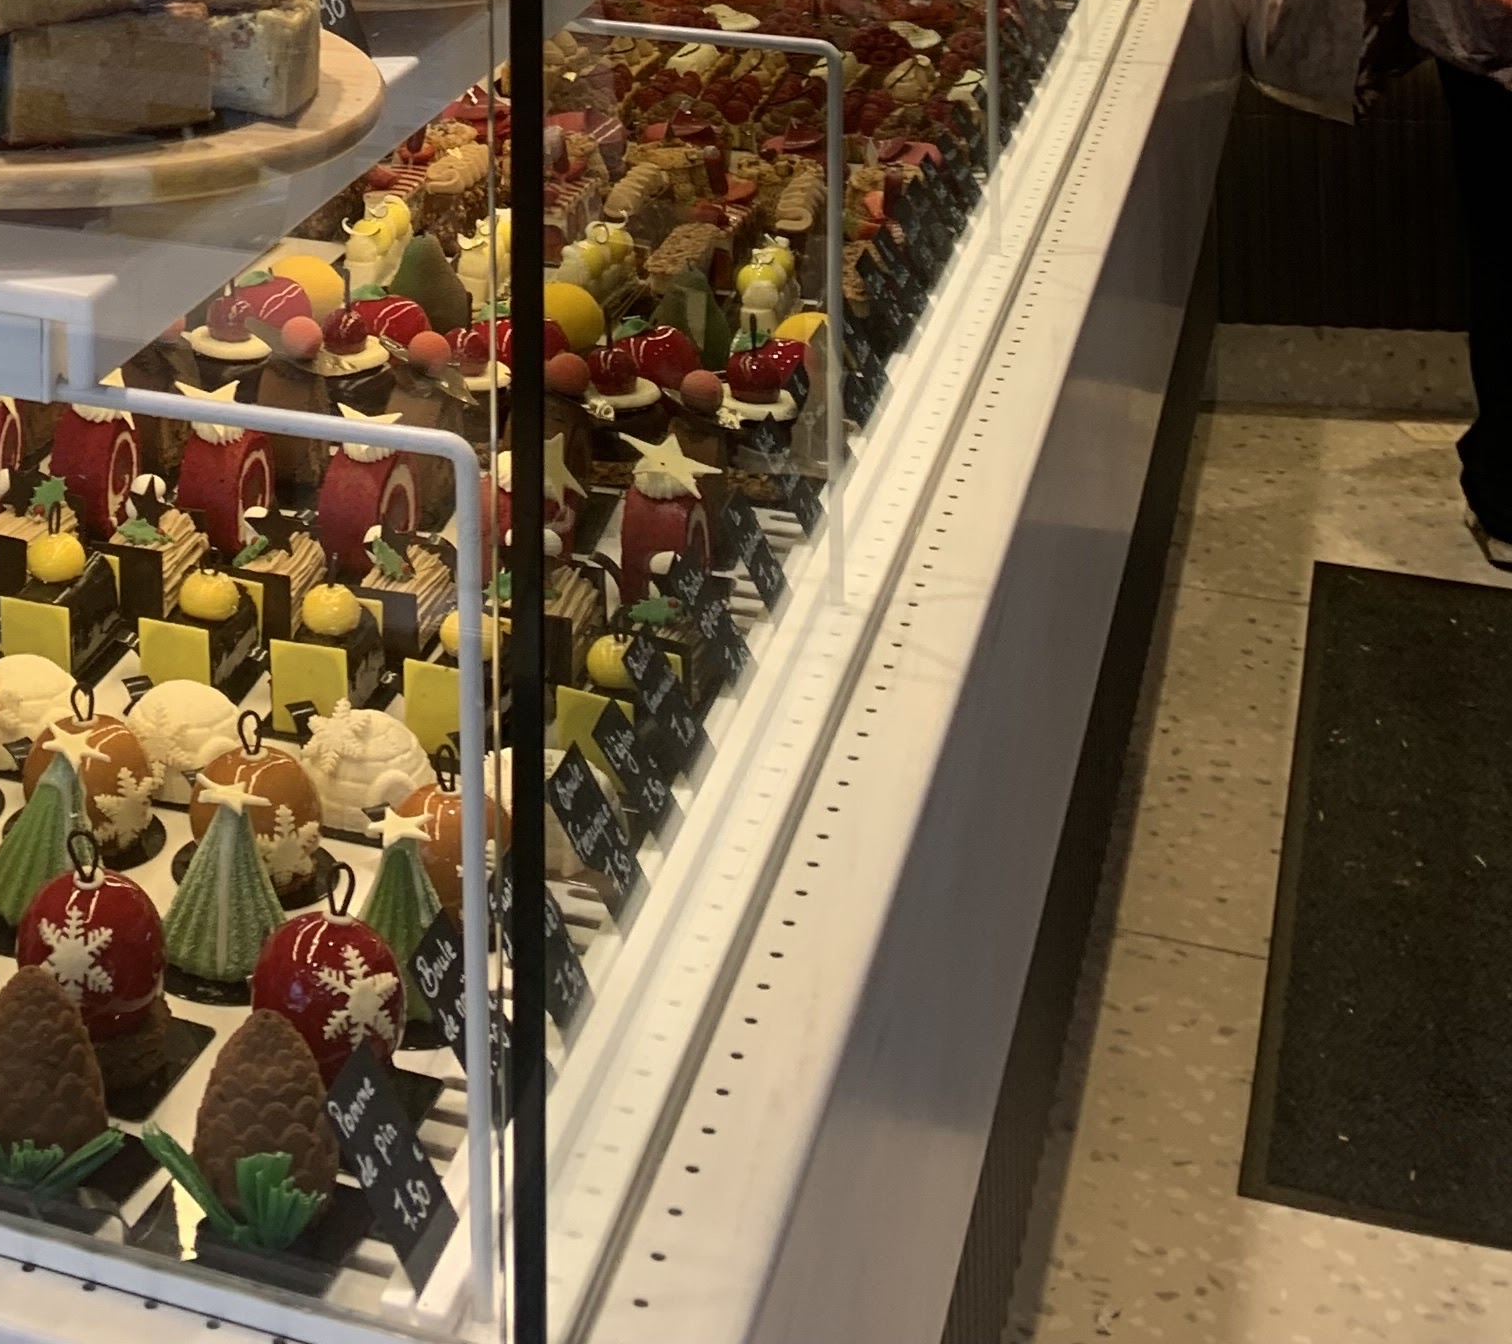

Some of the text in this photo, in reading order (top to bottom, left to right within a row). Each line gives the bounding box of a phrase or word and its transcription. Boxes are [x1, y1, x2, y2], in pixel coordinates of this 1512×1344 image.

[415, 937, 458, 999] Boule
[356, 1121, 398, 1189] de pin
